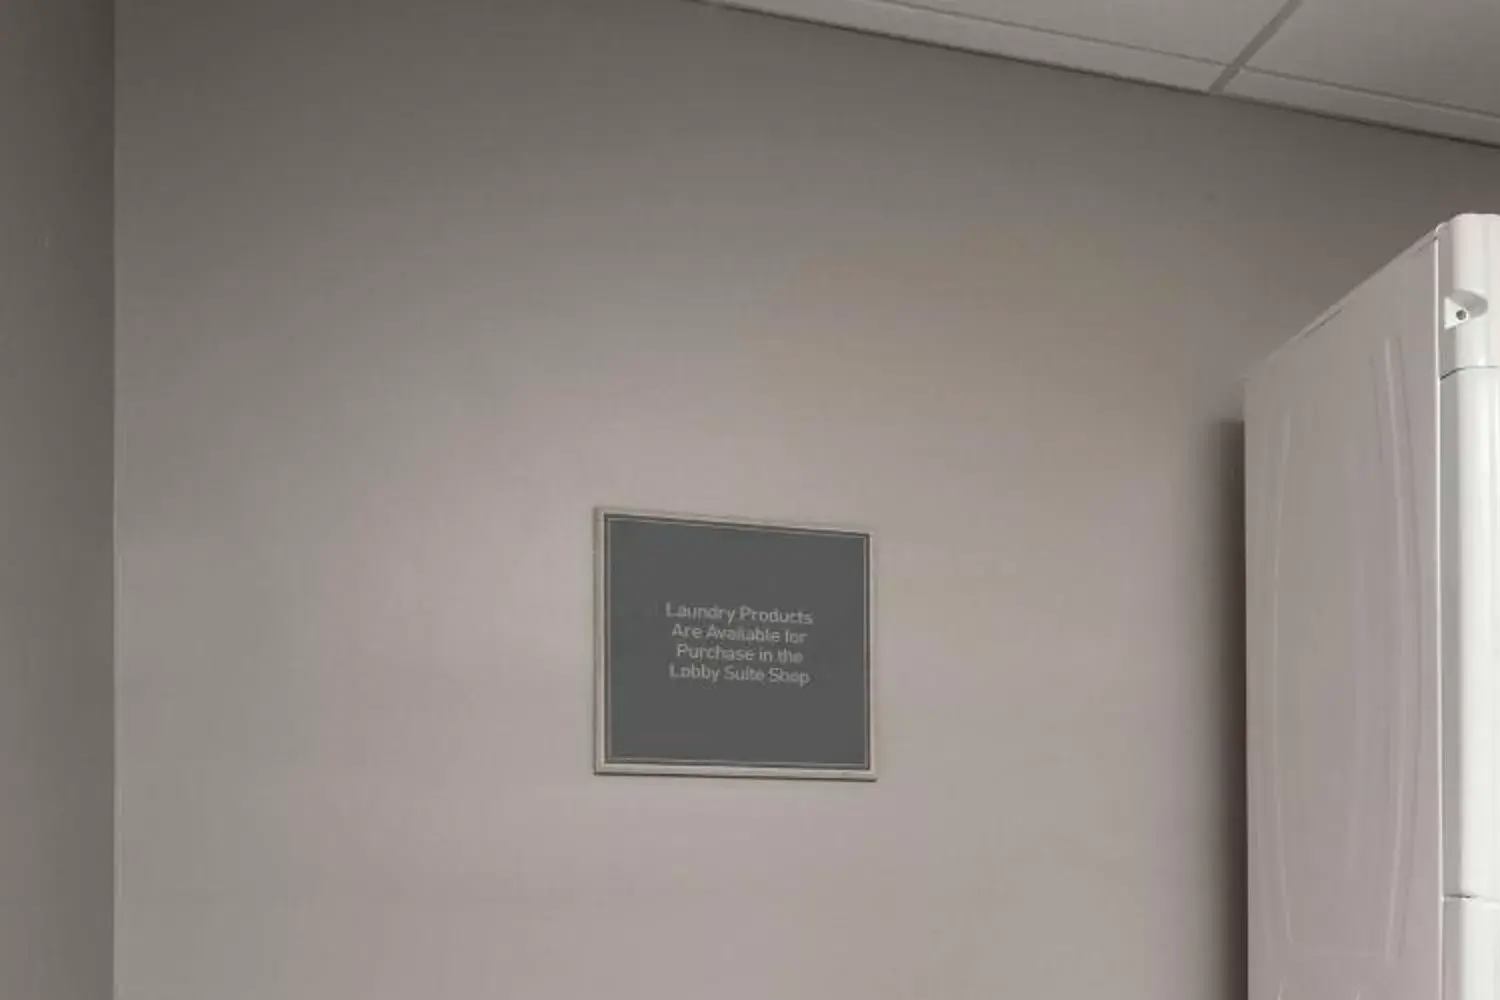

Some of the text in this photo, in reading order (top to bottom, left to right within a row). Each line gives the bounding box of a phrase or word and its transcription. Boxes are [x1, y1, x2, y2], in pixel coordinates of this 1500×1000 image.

[665, 602, 814, 625] Laundry Products
[671, 623, 703, 639] Are
[706, 624, 781, 643] Available
[677, 642, 804, 664] Purchase in the
[669, 662, 811, 687] Lobby Suite Shop
